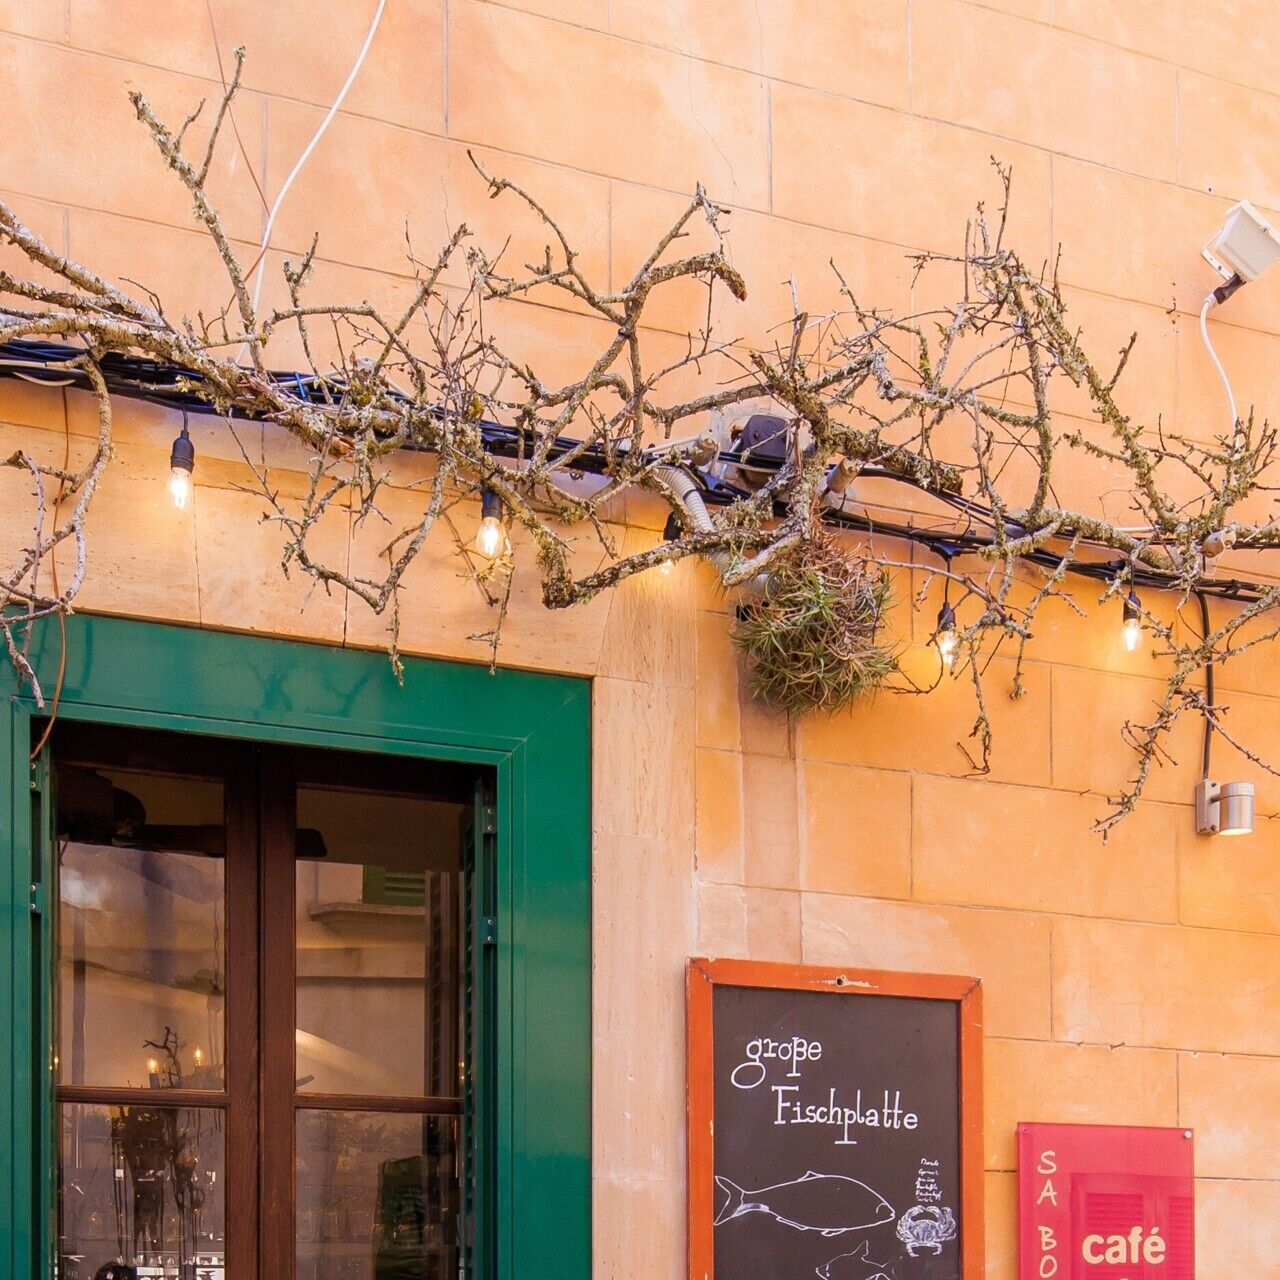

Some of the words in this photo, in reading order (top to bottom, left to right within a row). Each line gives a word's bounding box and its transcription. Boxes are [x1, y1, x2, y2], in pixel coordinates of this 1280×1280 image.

[730, 1036, 823, 1089] große
[771, 1085, 919, 1145] Fischplatte
[1036, 1149, 1058, 1206] SA
[1081, 1225, 1167, 1265] café
